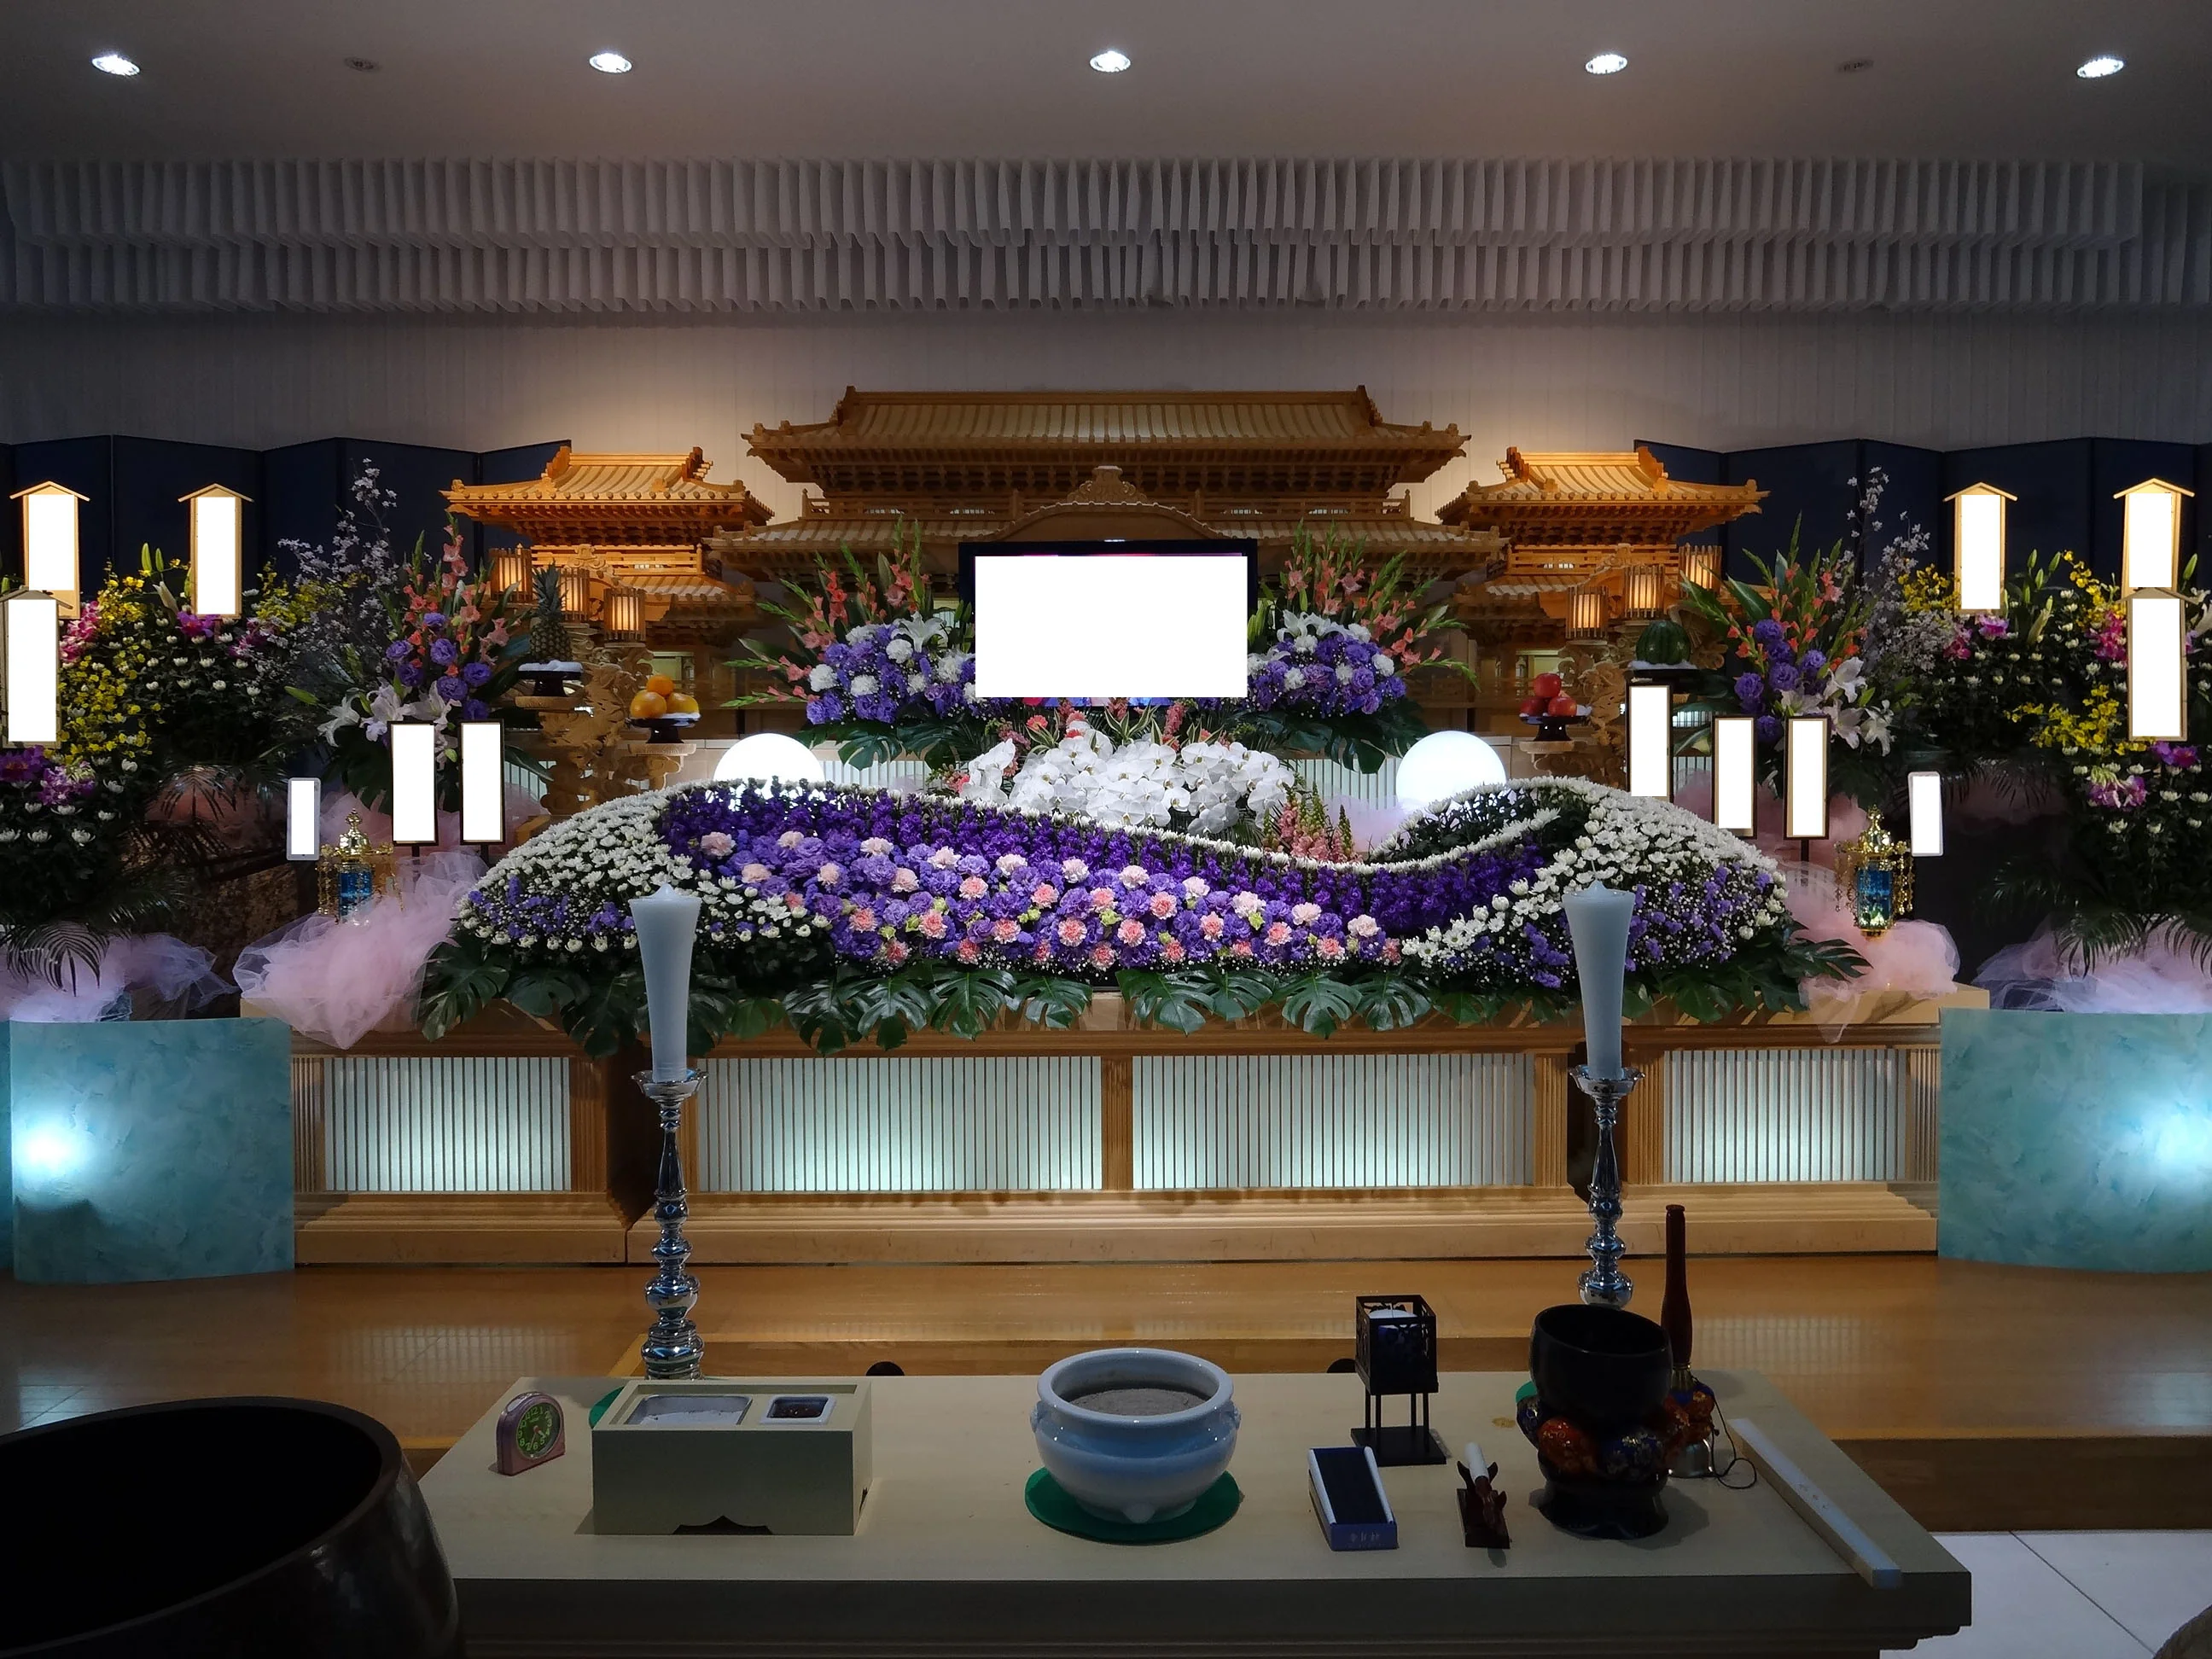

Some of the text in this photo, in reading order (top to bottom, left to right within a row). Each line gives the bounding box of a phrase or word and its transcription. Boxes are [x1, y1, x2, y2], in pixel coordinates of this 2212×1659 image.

[545, 1411, 550, 1419] 2
[547, 1418, 552, 1427] 3
[519, 1438, 525, 1447] 8
